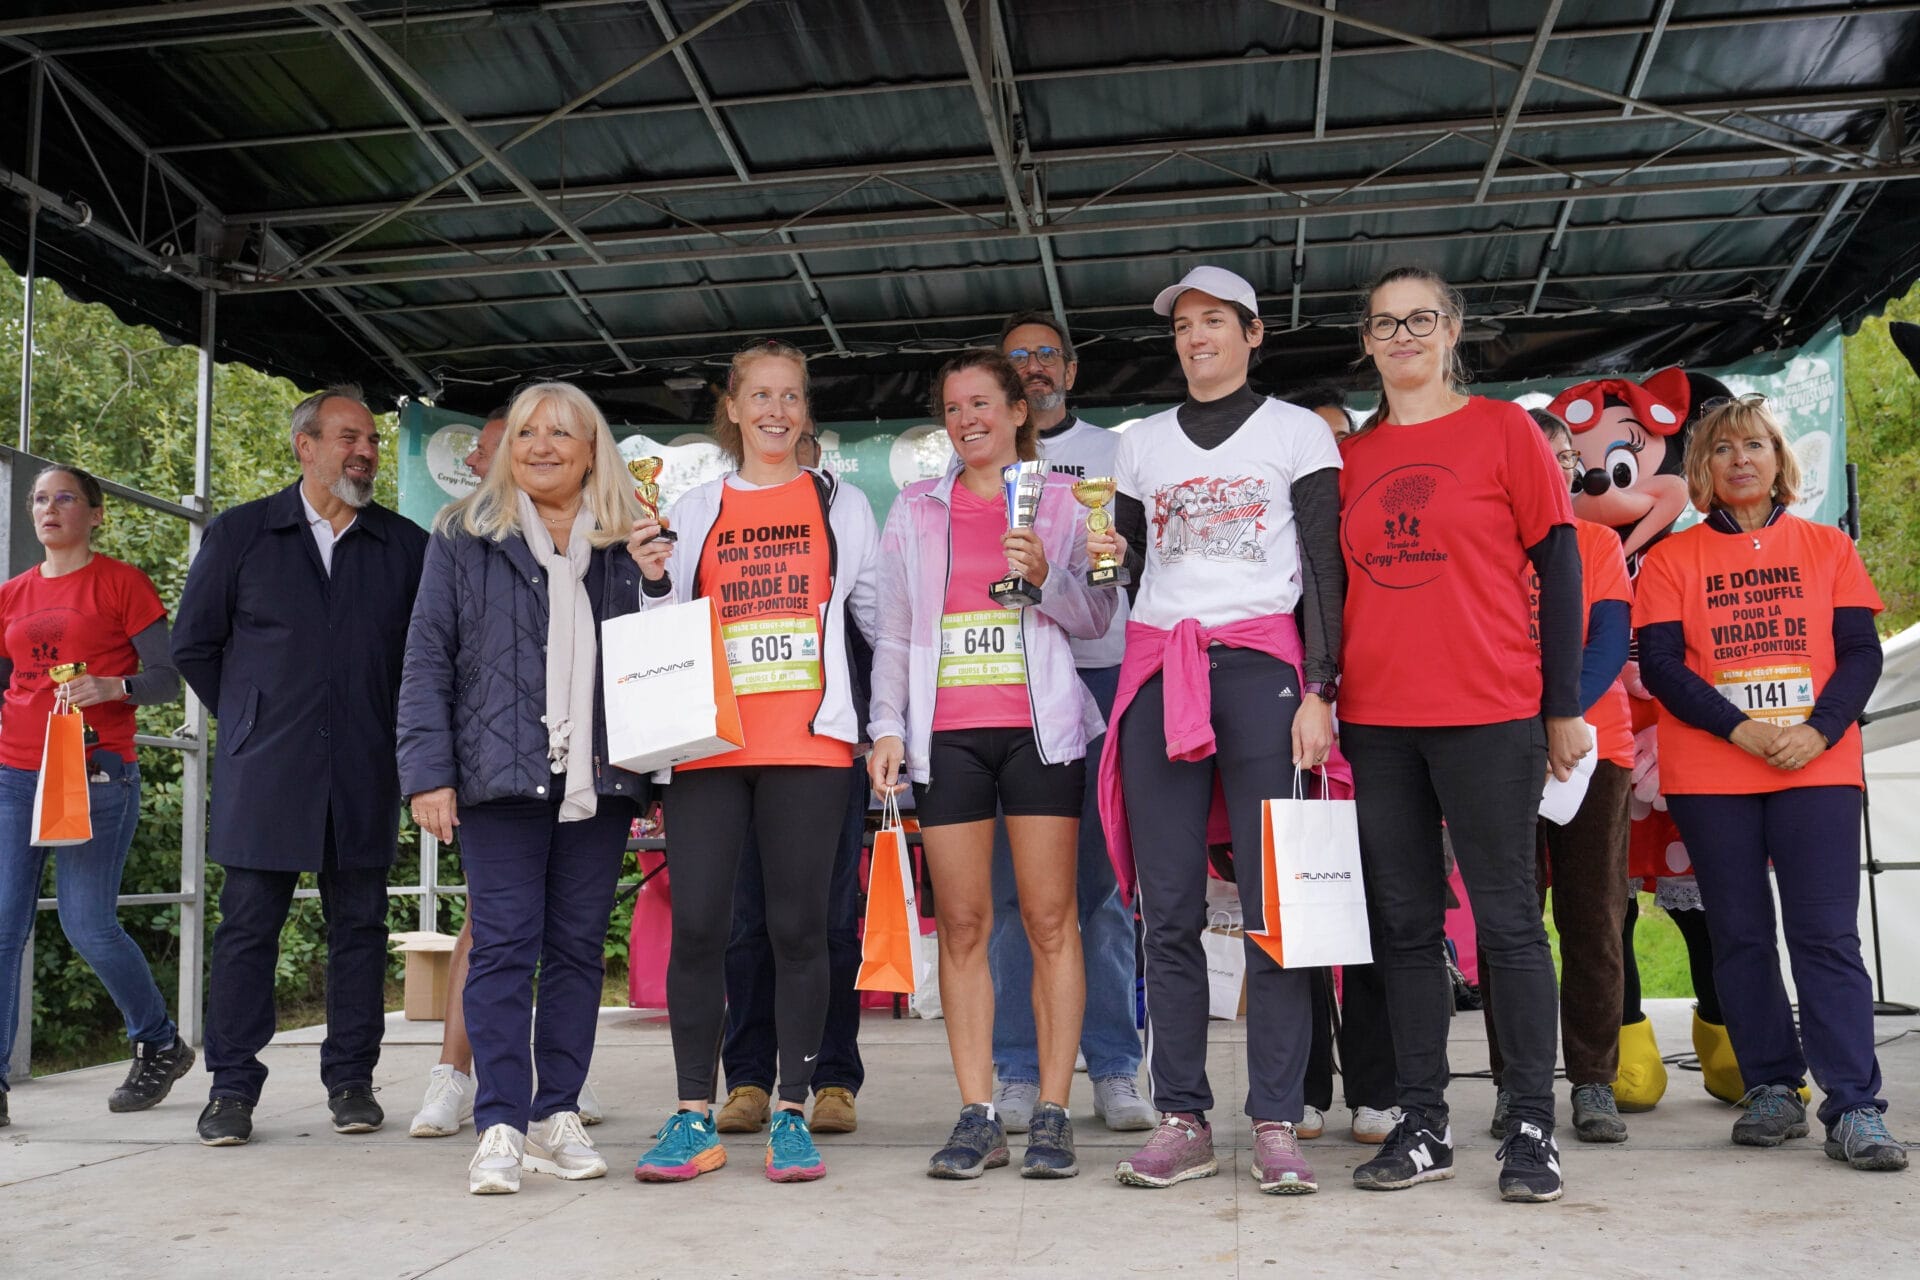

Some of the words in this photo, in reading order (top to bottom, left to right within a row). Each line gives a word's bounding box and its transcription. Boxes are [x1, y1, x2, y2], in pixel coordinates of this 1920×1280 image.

[717, 530, 735, 546] JE
[743, 525, 810, 542] DONNE
[1387, 541, 1409, 549] Virade
[718, 547, 748, 564] MON
[754, 541, 810, 559] SOUFFLE
[1365, 549, 1448, 567] Cergy-Pontoise
[741, 564, 771, 577] POUR
[775, 562, 787, 573] LA
[1706, 575, 1724, 593] JE
[1731, 567, 1801, 588] DONNE
[721, 577, 782, 602] VIRADE
[789, 575, 808, 594] DE
[1708, 593, 1739, 609] MON
[1745, 586, 1803, 604] SOUFFLE
[722, 597, 808, 618] CERGY-PONTOISE
[1733, 608, 1764, 621] POUR
[1769, 605, 1781, 616] LA
[965, 627, 1004, 654] 640
[1711, 620, 1779, 645] VIRADE
[1785, 618, 1806, 636] DE
[752, 635, 792, 662] 605
[1714, 639, 1806, 660] CERGY-PONTOISE
[1745, 682, 1786, 708] 1141
